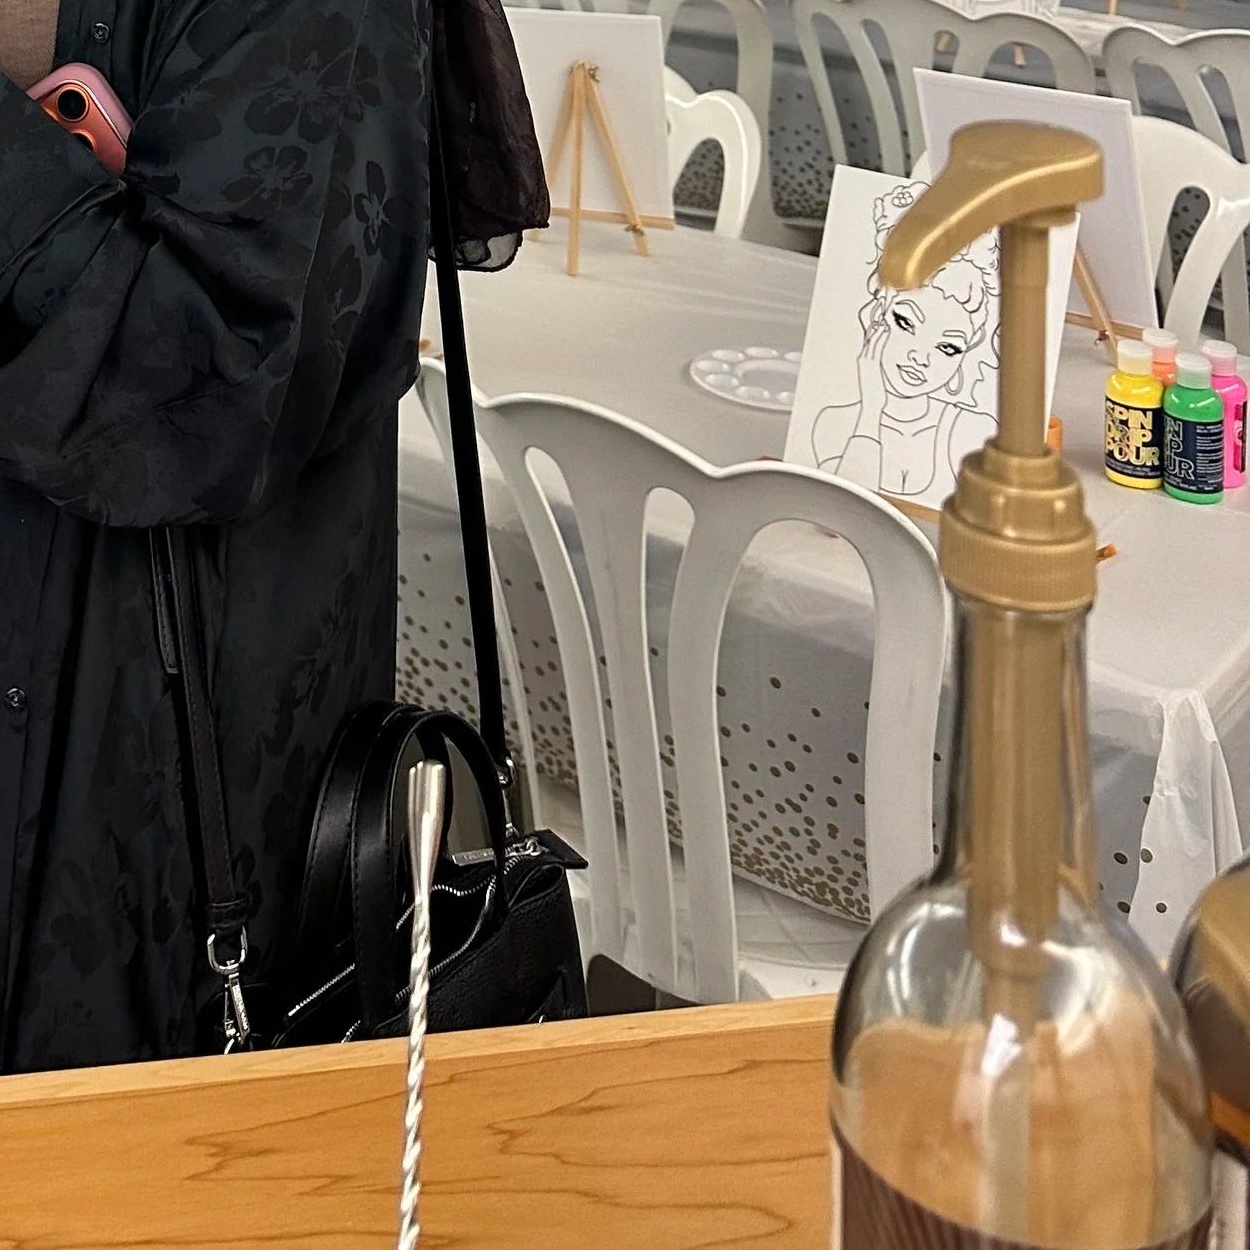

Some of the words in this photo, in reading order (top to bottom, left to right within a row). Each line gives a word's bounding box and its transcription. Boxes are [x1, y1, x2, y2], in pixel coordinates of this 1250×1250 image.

[1106, 400, 1153, 430] SPIN
[1106, 437, 1159, 465] POUR
[1165, 453, 1195, 480] UR
